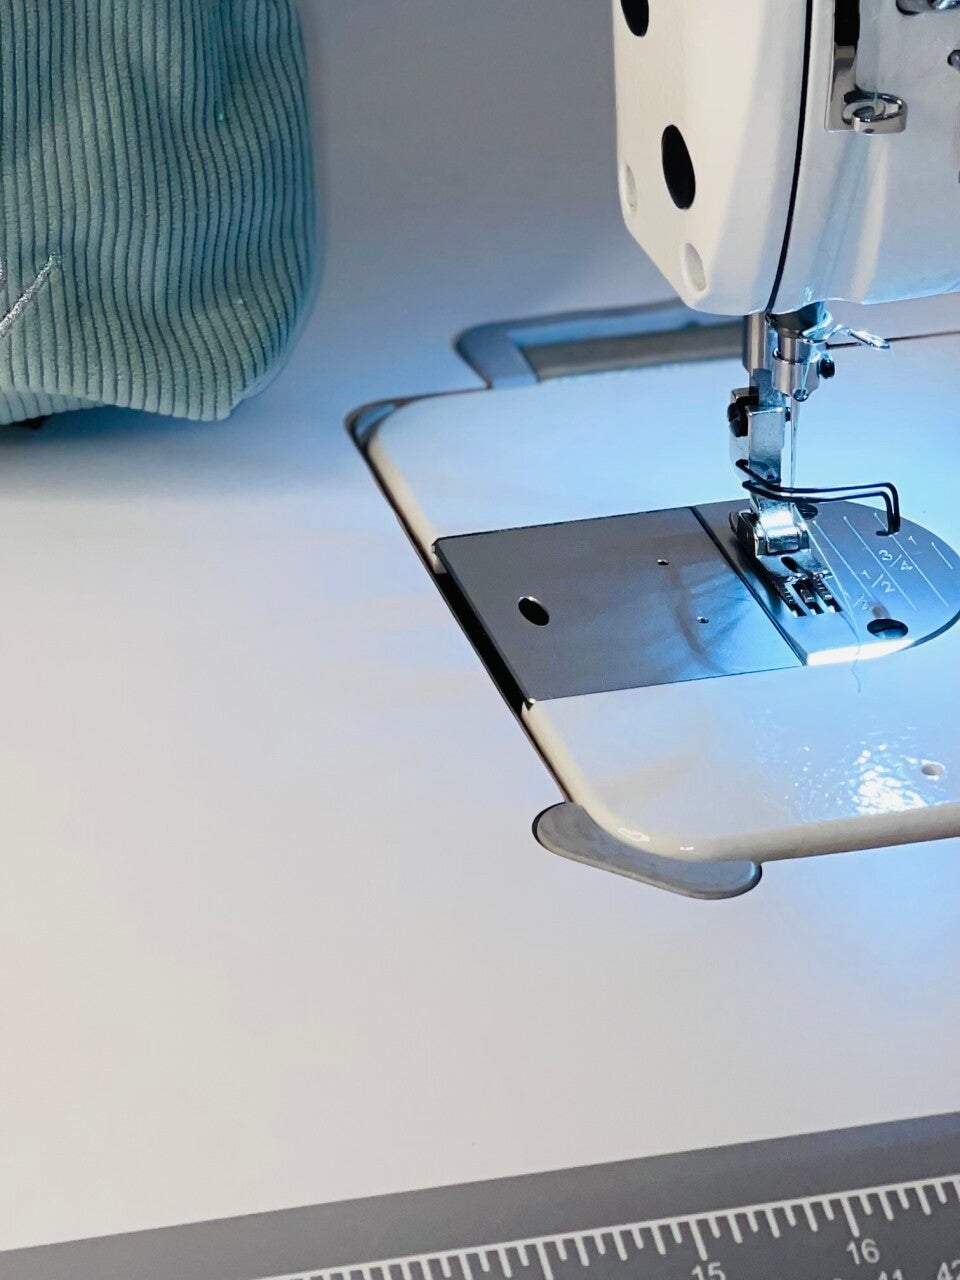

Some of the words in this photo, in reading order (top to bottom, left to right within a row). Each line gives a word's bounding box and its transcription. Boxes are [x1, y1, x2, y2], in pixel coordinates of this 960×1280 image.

[878, 549, 914, 571] 3/4
[862, 569, 896, 593] 1/2
[691, 1261, 726, 1280] 15
[846, 1238, 880, 1265] 16
